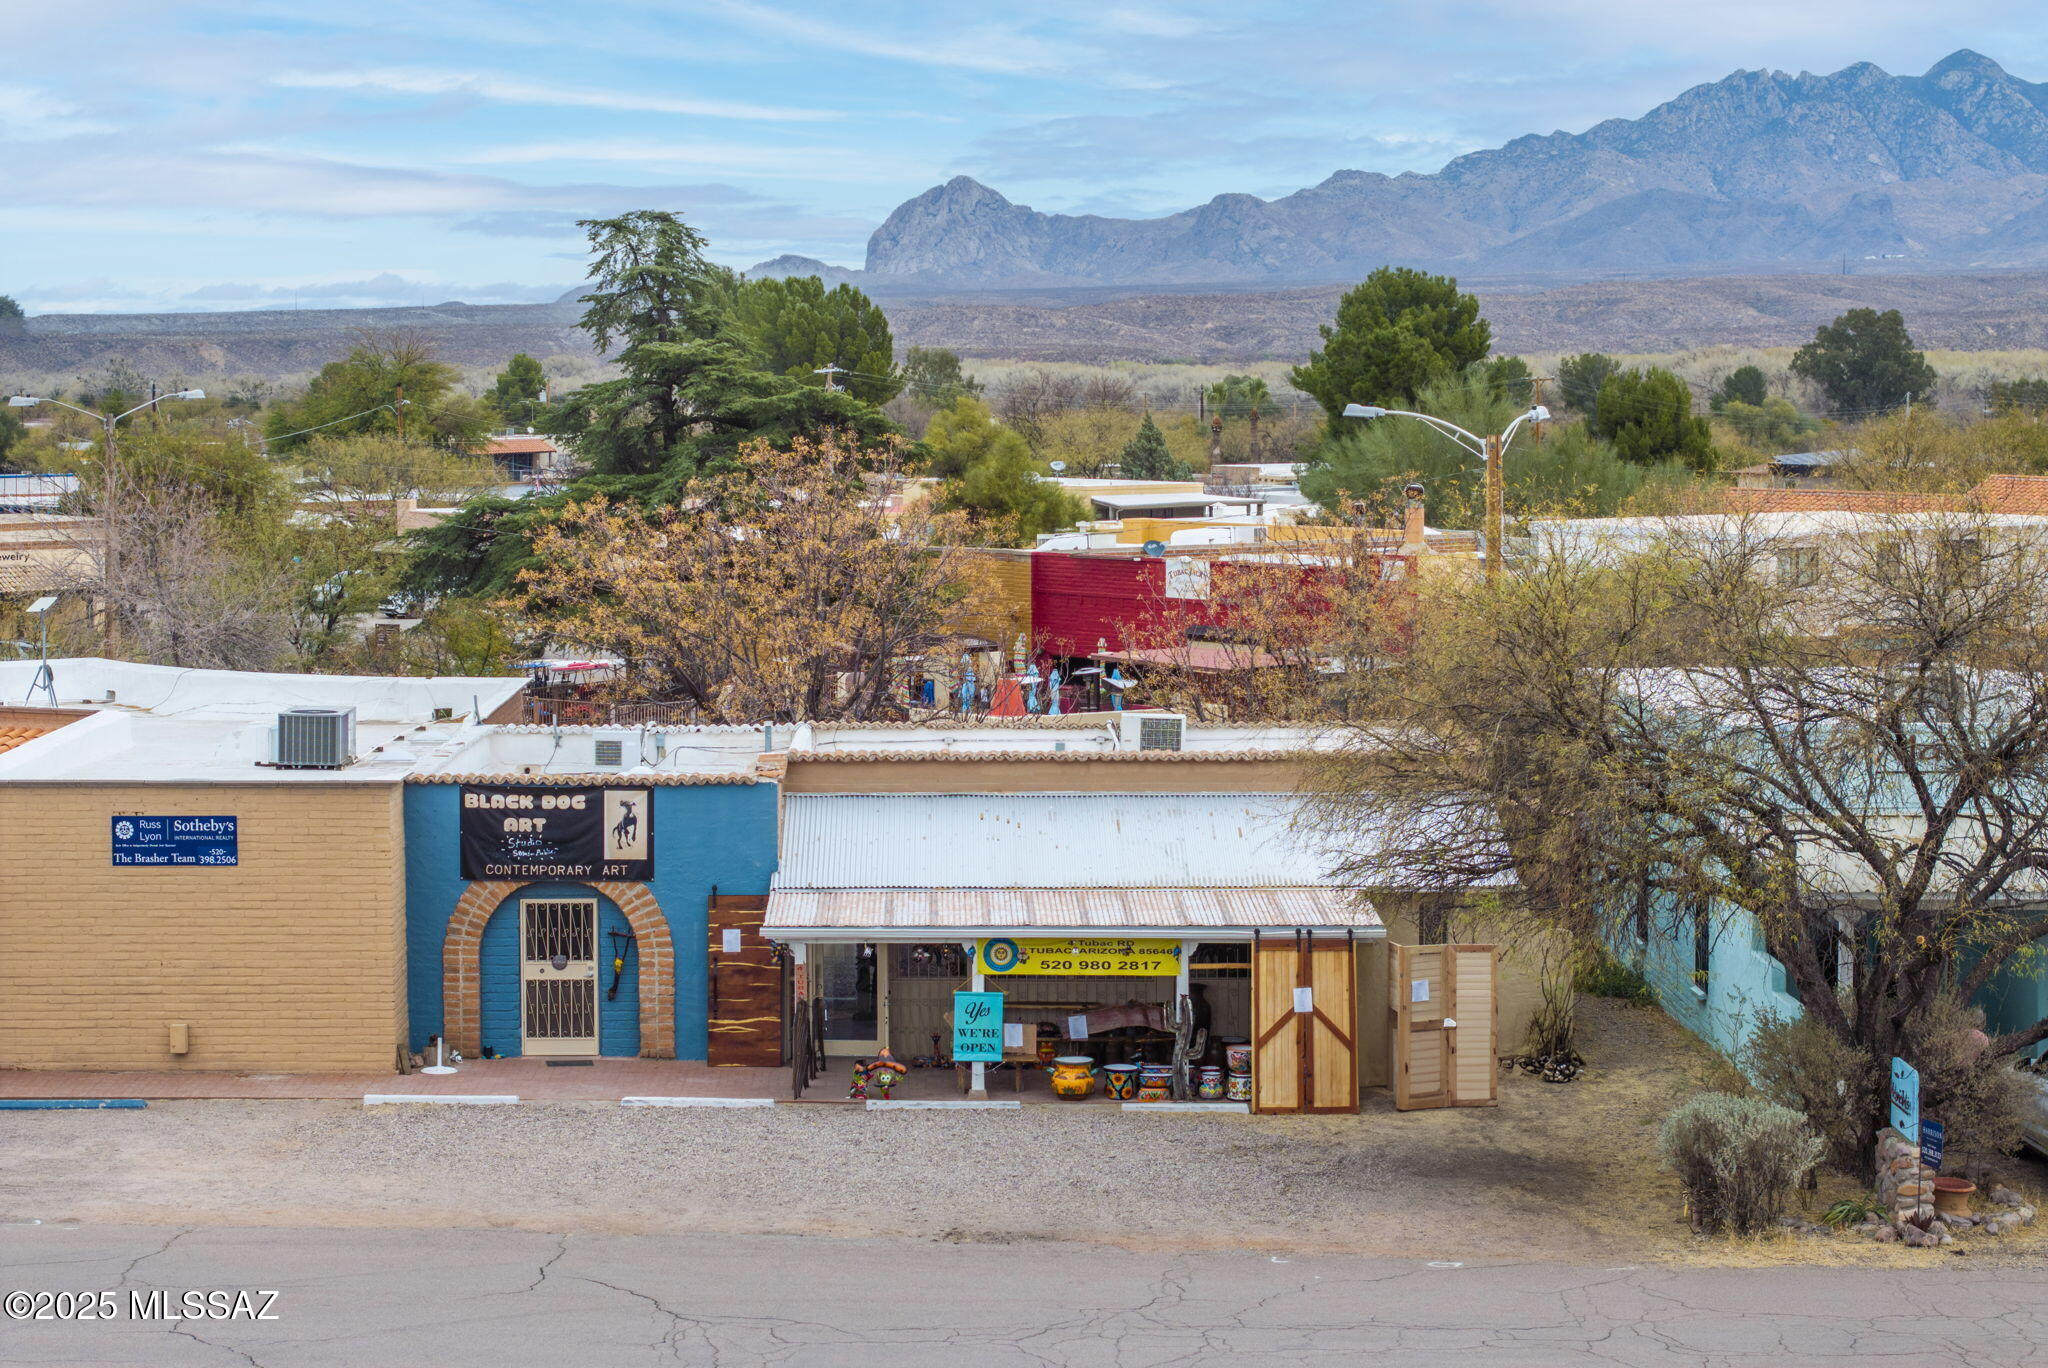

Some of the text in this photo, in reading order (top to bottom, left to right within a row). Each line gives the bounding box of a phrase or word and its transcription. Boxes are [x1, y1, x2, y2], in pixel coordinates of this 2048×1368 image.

[464, 793, 586, 809] BLACK DOG
[140, 820, 161, 829] Russ
[174, 819, 234, 834] Sotheby's
[503, 817, 546, 832] ART
[140, 832, 162, 842] Lyon
[507, 837, 543, 848] Studio
[114, 853, 237, 864] The Brasher Team 398.2506
[485, 864, 628, 876] CONTEMPORARY ART
[1040, 960, 1161, 971] 520 980 2817
[965, 1001, 990, 1025] Yes
[958, 1028, 999, 1038] WE'RE
[960, 1043, 996, 1053] OPEN
